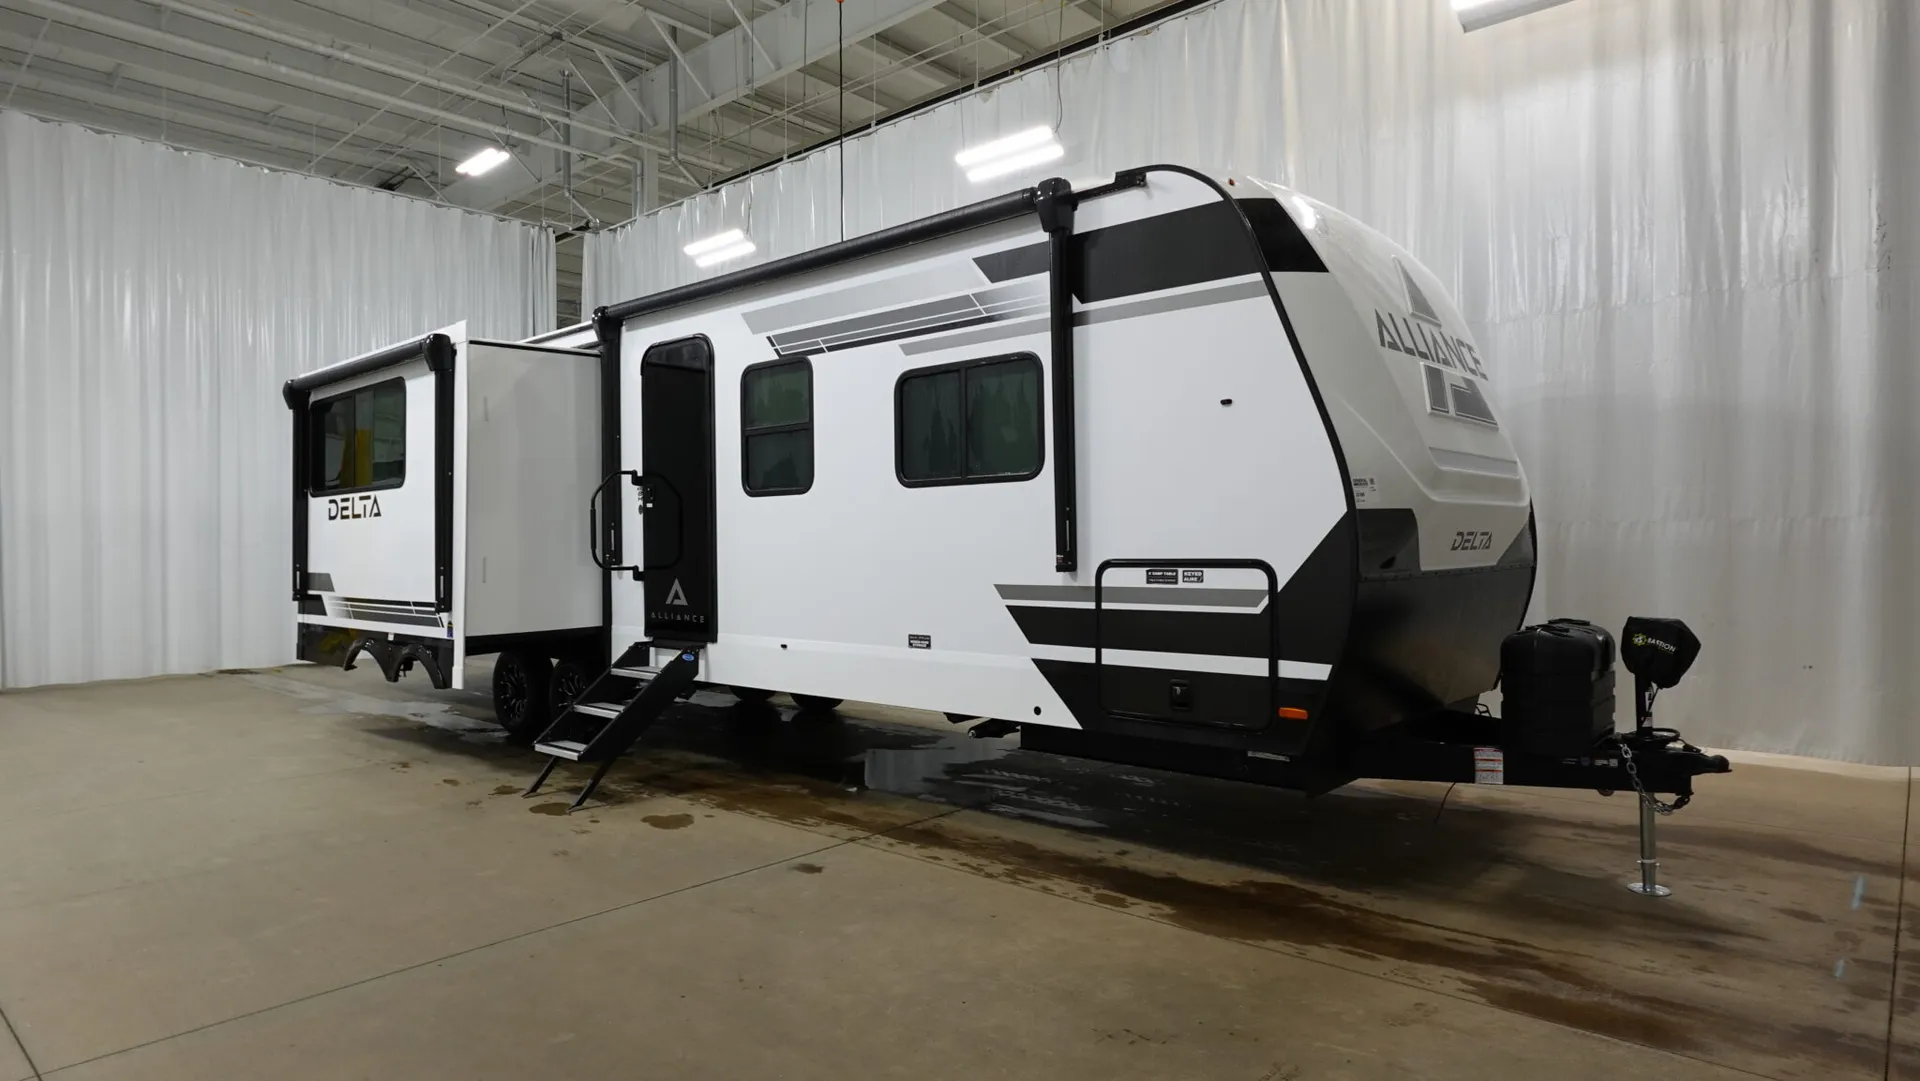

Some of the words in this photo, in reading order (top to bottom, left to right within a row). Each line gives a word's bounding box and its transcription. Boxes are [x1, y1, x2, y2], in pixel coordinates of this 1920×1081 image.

[1374, 308, 1489, 381] ALLIANCE
[328, 494, 382, 521] DELTA
[1450, 531, 1492, 551] DELTA
[650, 611, 705, 624] ALLIANCE
[1647, 637, 1677, 652] BASTION
